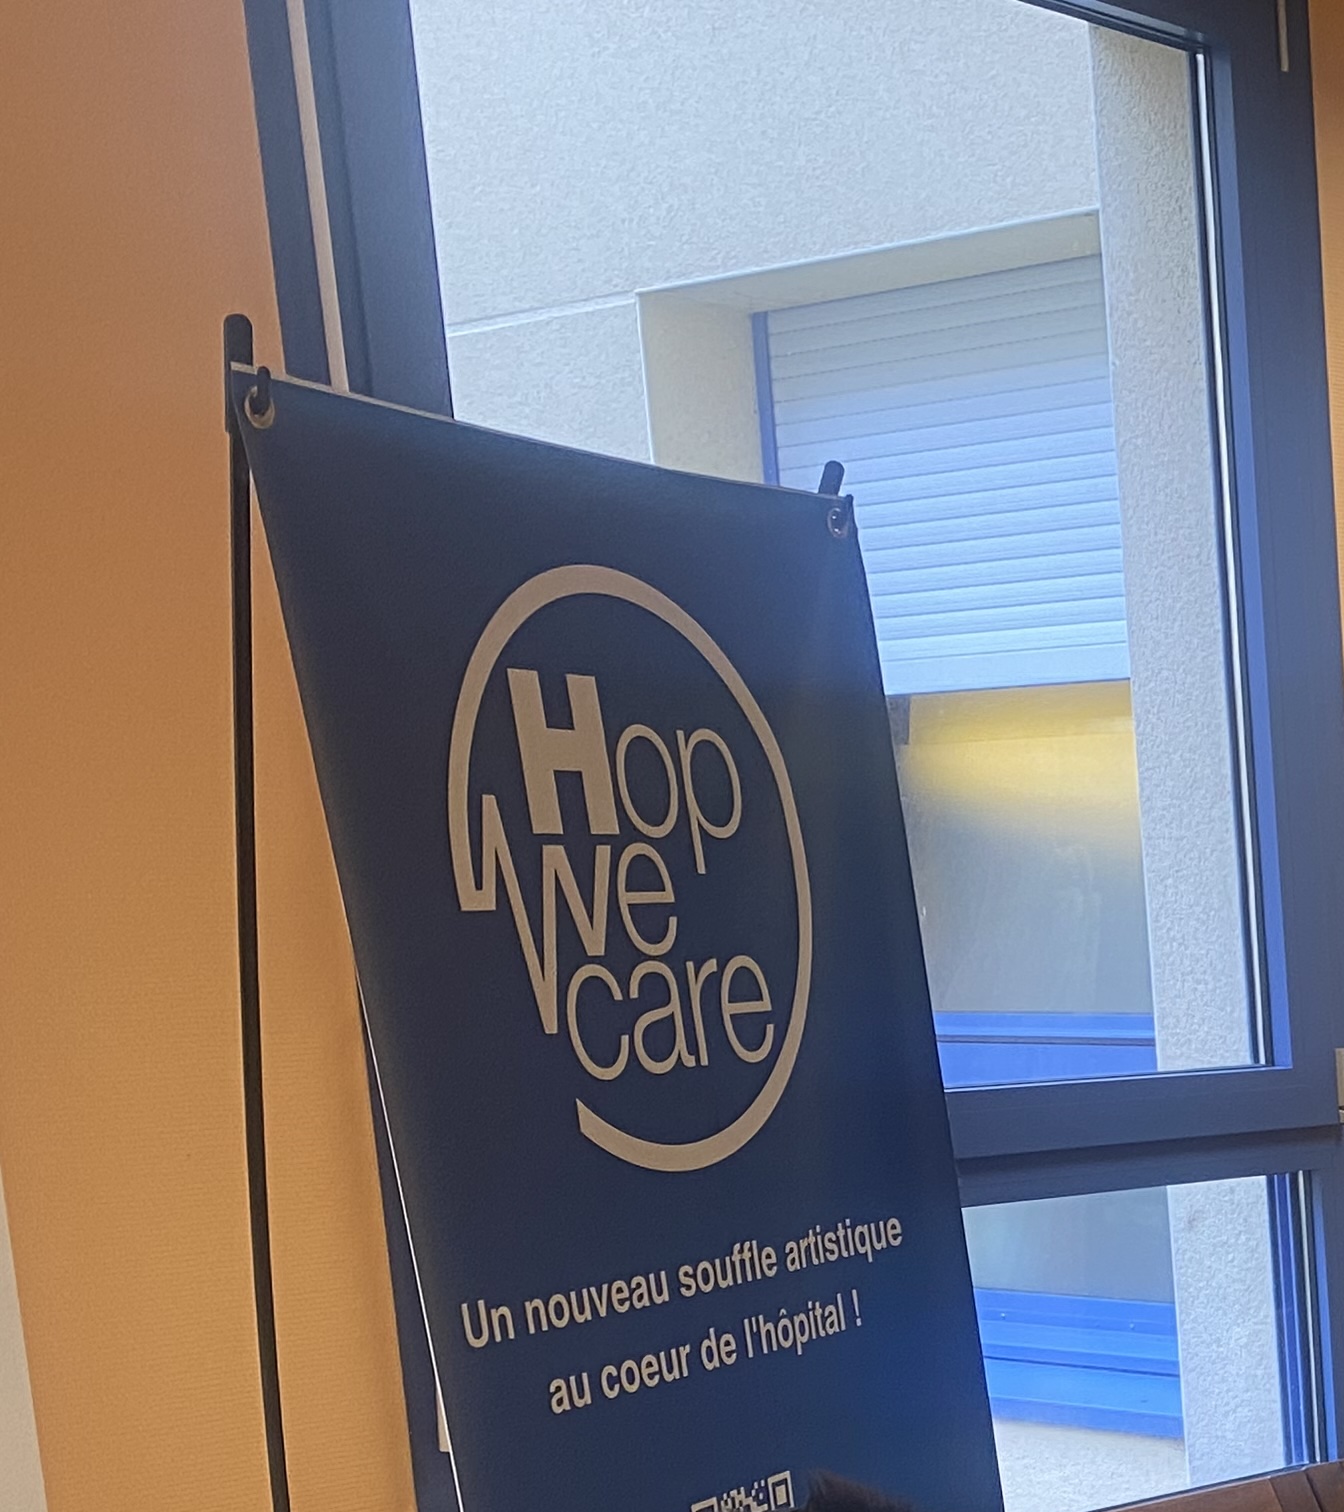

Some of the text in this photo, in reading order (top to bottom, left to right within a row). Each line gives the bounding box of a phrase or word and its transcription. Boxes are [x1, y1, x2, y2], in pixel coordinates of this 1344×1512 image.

[505, 667, 743, 875] Hop
[566, 954, 775, 1082] care
[461, 1217, 903, 1348] Un nouveau souffle artistique
[549, 1289, 862, 1414] au coeur de l'hôpital !
